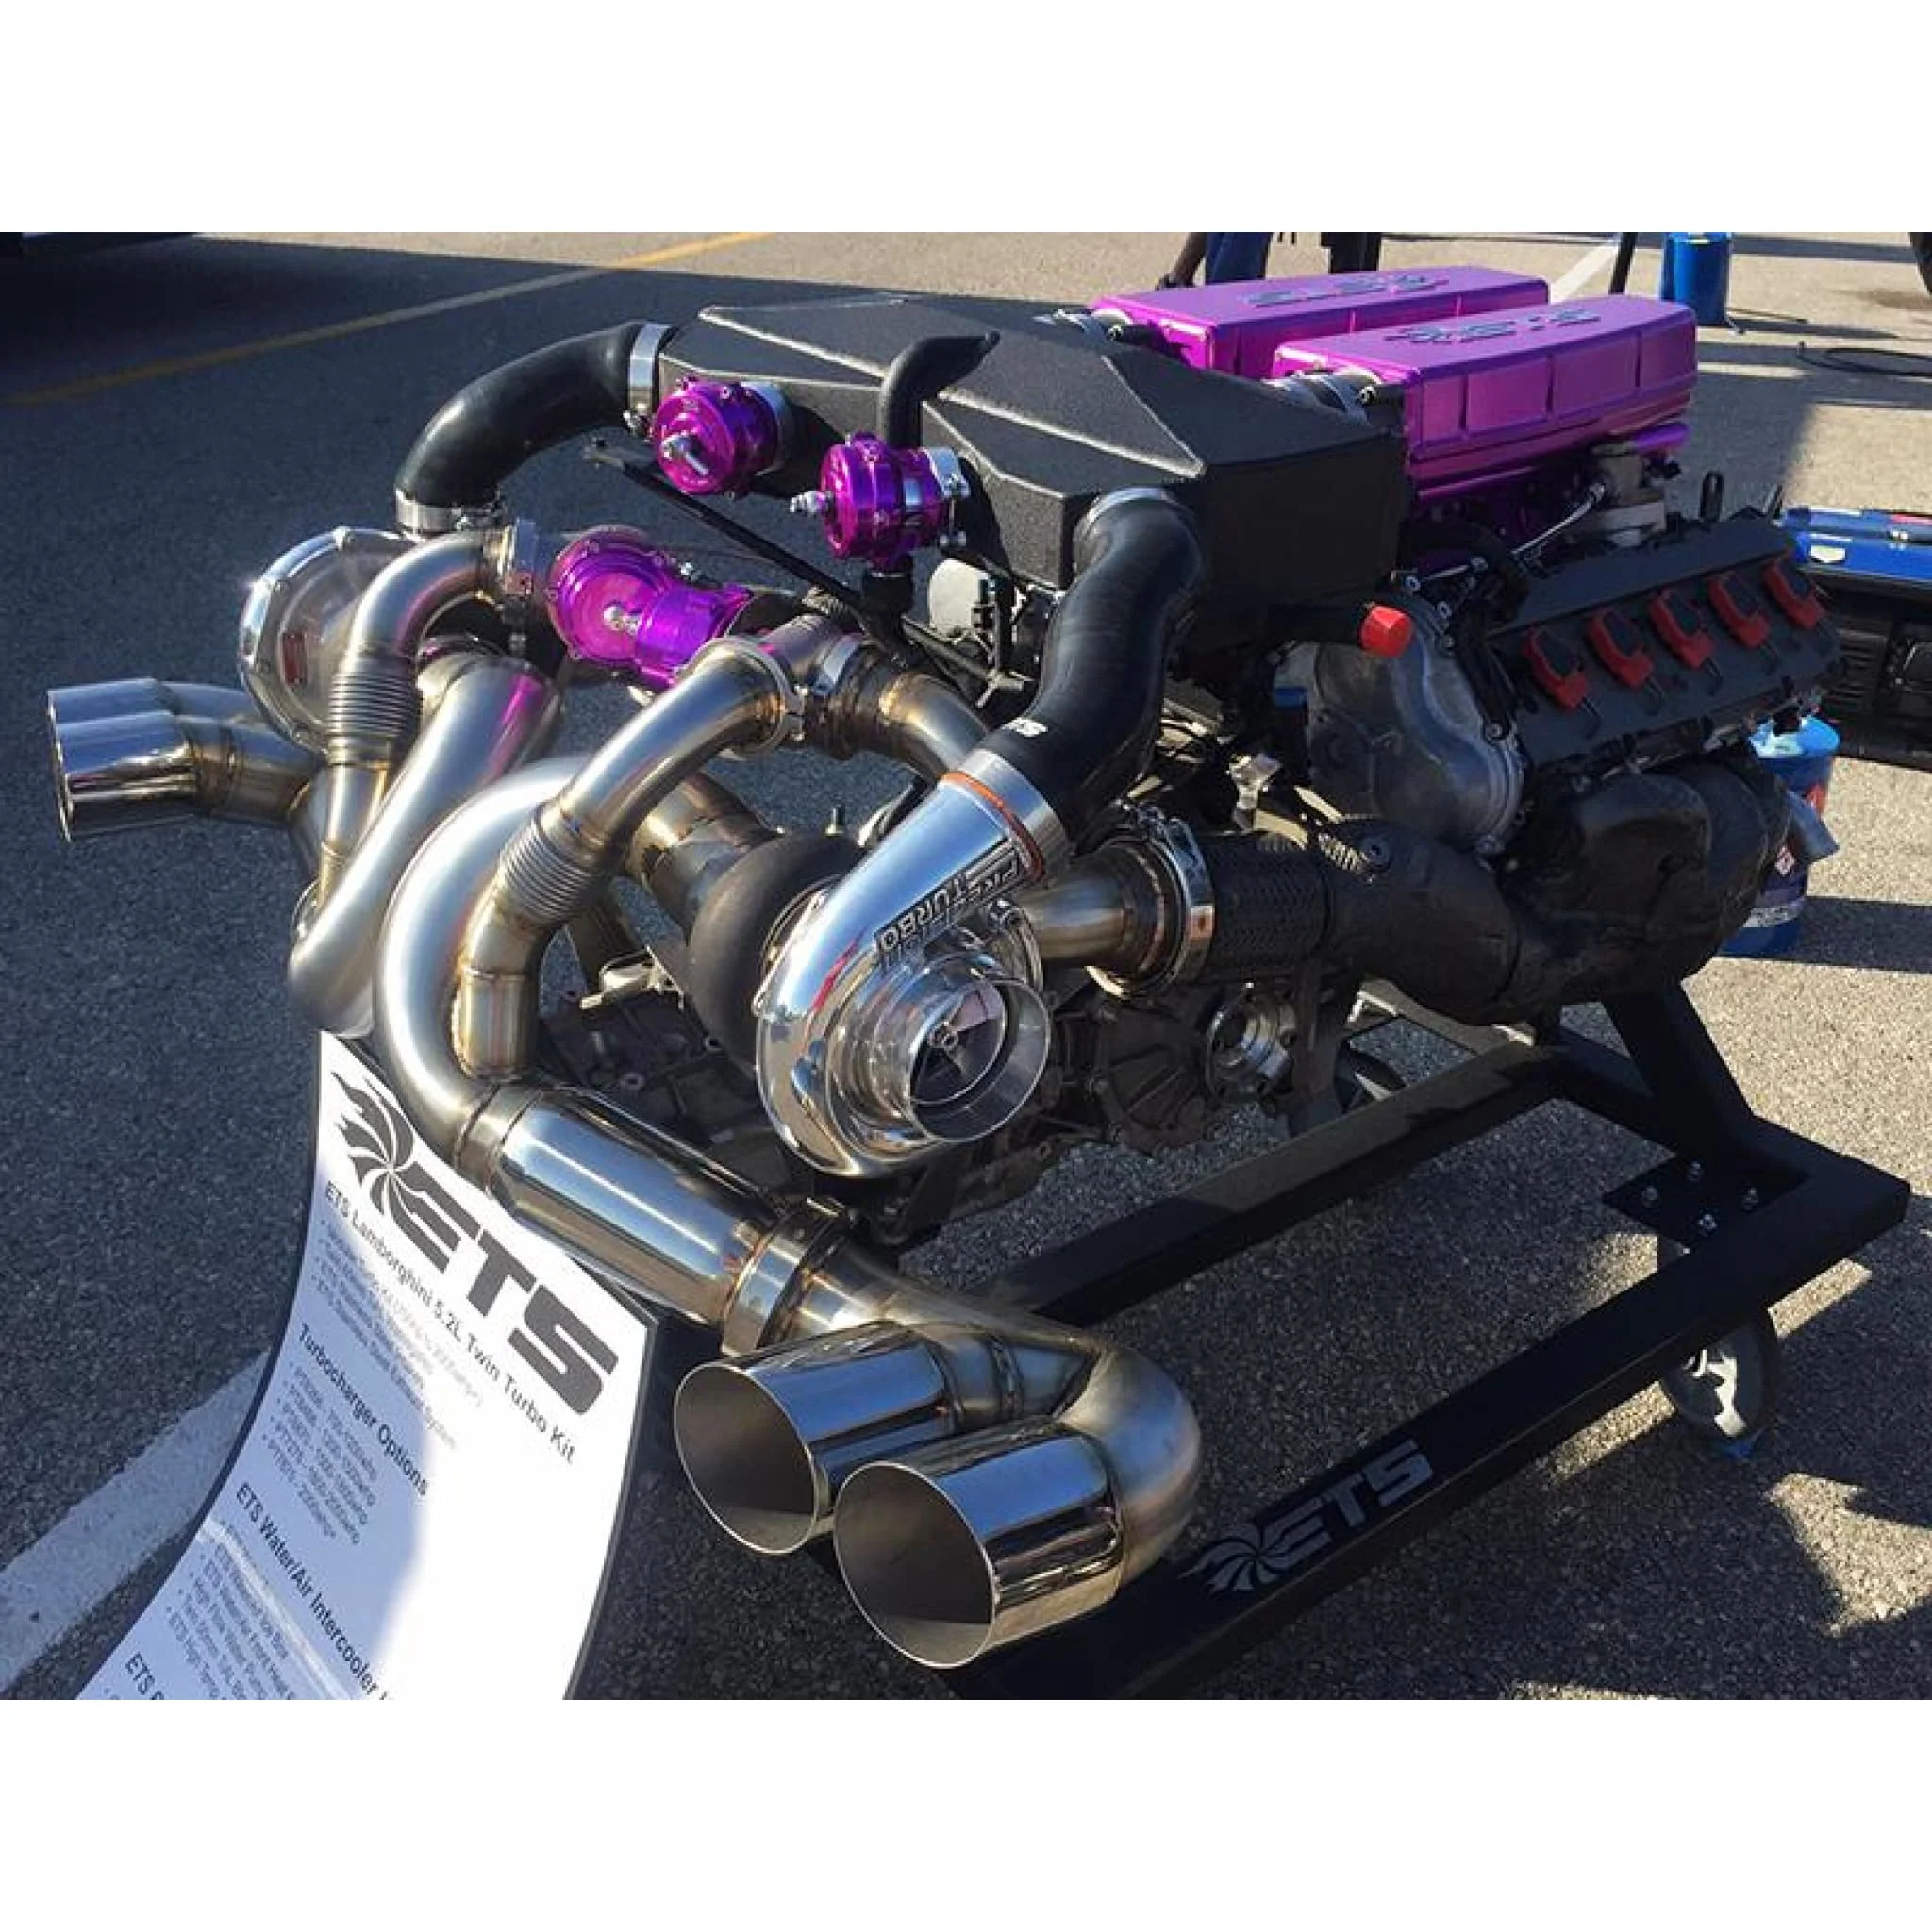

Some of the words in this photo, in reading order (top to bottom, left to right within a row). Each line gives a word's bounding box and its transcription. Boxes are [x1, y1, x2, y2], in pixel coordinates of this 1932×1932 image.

[878, 874, 968, 951] TURBO
[325, 1180, 349, 1218] ETS
[352, 1208, 432, 1307] Lamborghini
[434, 1298, 462, 1343] 5.2L
[467, 1332, 501, 1382] Twin
[504, 1373, 547, 1433] Turbo
[550, 1425, 575, 1465] Kit
[388, 1160, 619, 1415] ETS
[299, 1322, 377, 1428] Turbocharger
[378, 1424, 428, 1496] Options
[236, 1482, 264, 1523] ETS
[260, 1515, 314, 1597] Water/Air
[309, 1592, 379, 1695] Intercooler
[1258, 1439, 1434, 1571] ETS
[125, 1652, 156, 1695] ETS
